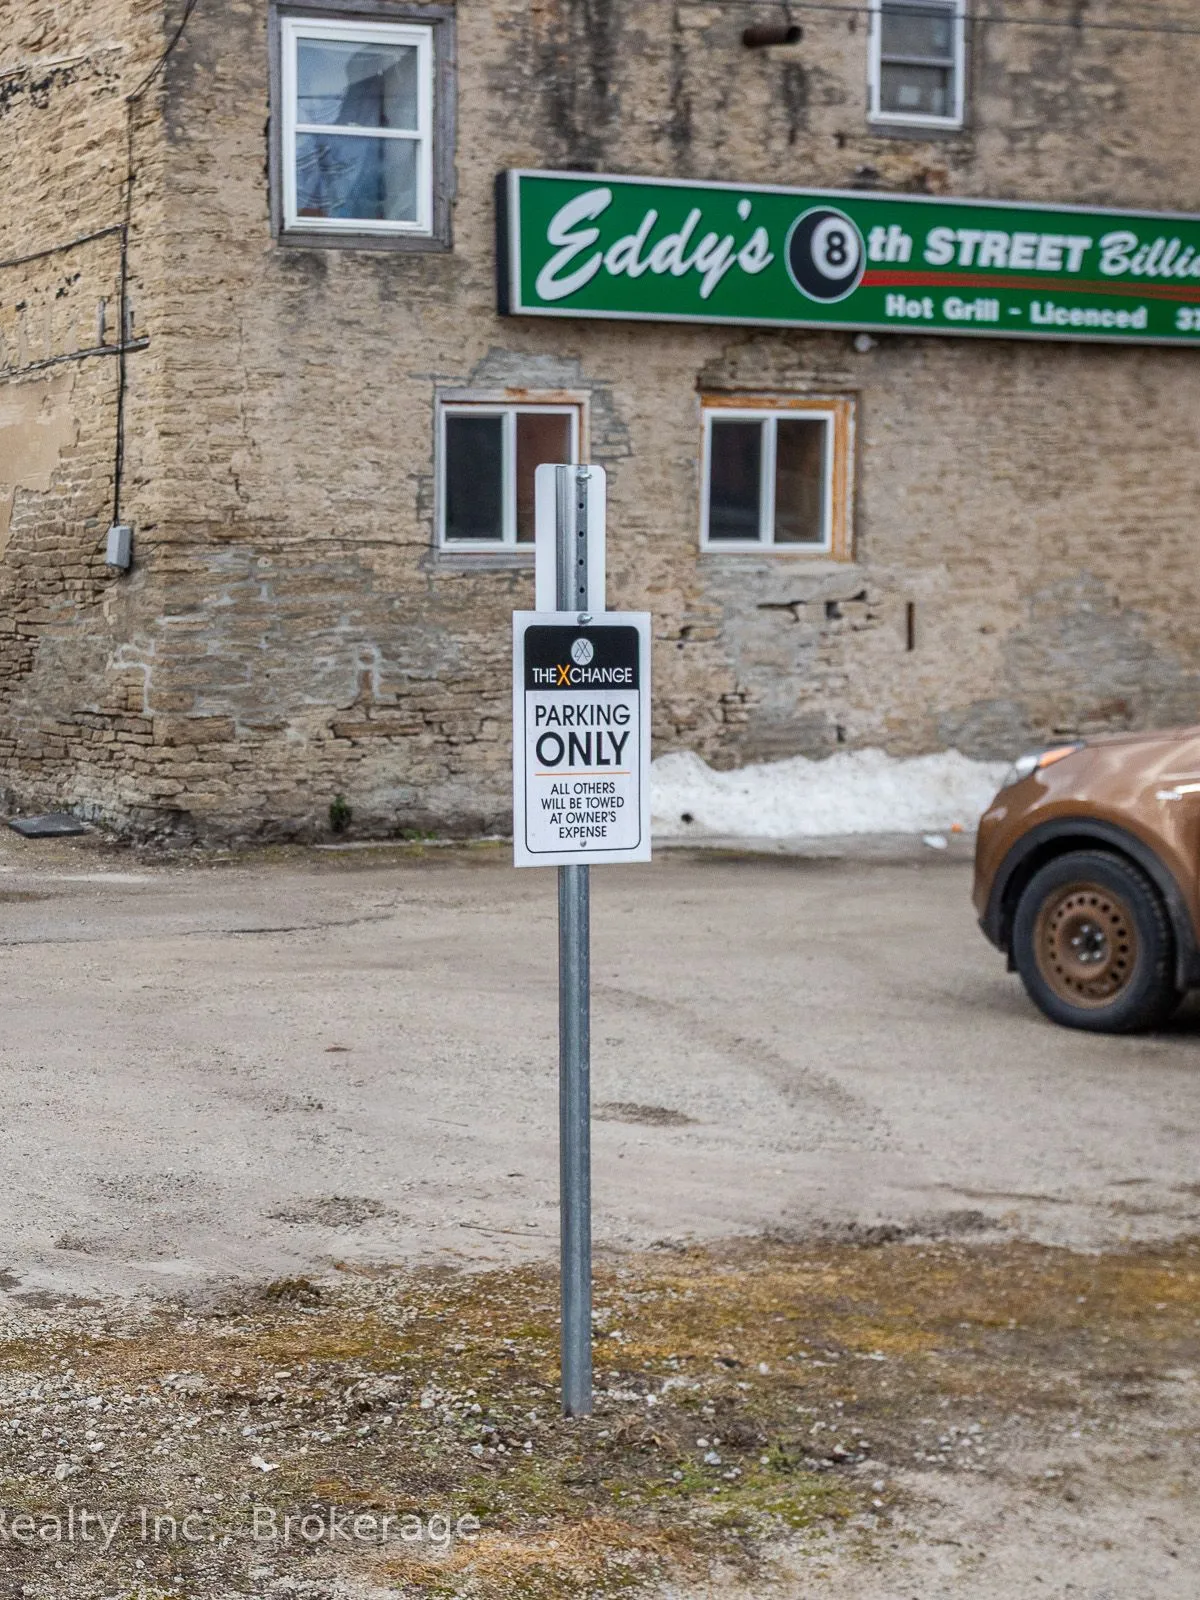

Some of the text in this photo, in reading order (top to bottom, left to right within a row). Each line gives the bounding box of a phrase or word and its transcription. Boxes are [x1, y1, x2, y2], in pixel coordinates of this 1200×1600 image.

[534, 187, 774, 300] Eddy's
[923, 226, 1093, 273] STREET
[884, 293, 934, 320] Hot
[942, 295, 1000, 322] Grill
[1029, 300, 1148, 330] Licenced
[535, 704, 631, 727] PARKING
[535, 731, 631, 767] ONLY
[550, 782, 615, 795] ALL OTHERS
[541, 796, 625, 810] WILL BE TOWED
[549, 811, 617, 825] AT OWNER'S
[559, 826, 607, 839] EXPENSE
